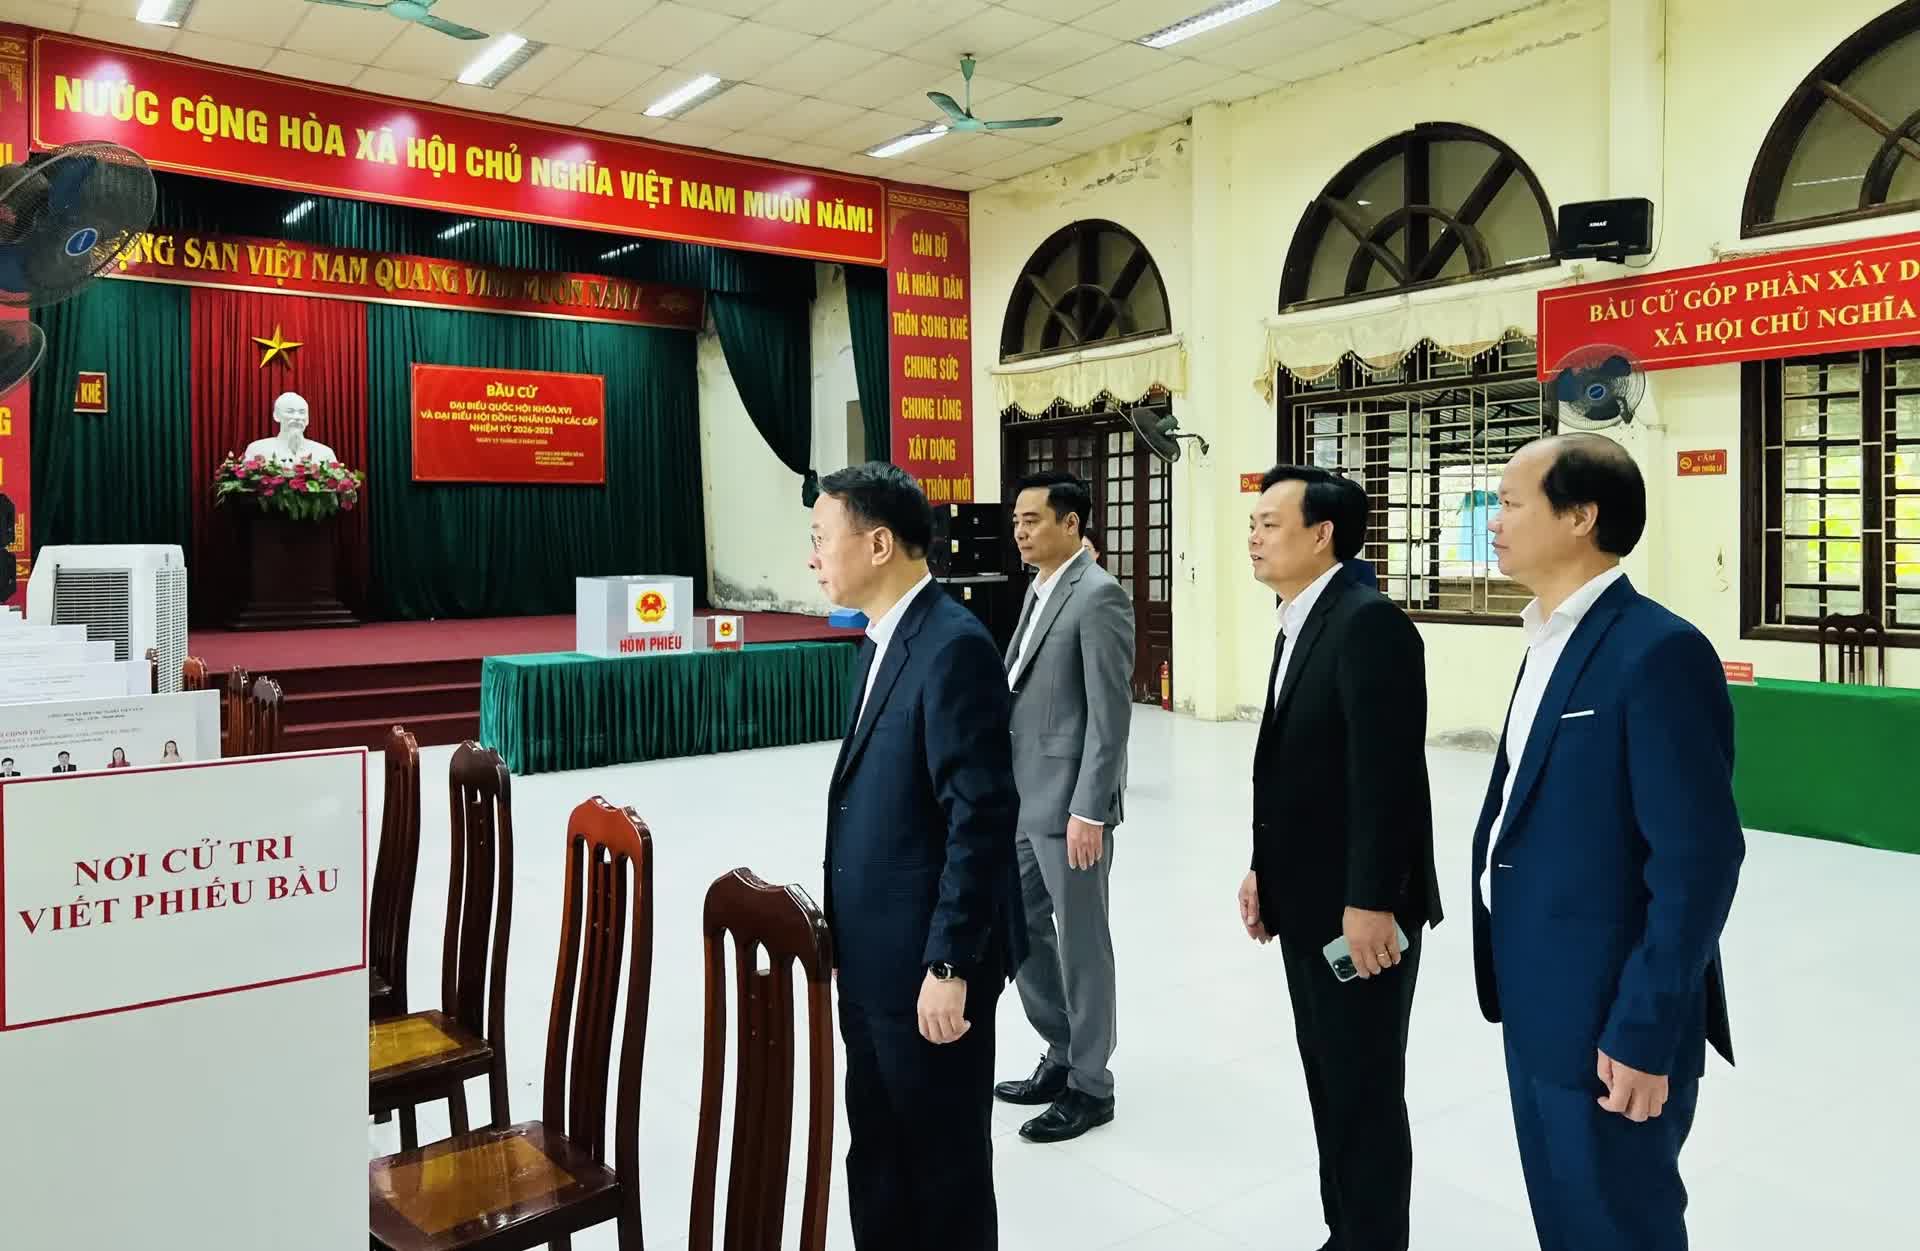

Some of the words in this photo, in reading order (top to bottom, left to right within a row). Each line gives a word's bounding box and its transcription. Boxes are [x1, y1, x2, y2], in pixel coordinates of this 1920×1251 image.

[55, 75, 159, 126] NƯỚC
[171, 94, 268, 145] CỘNG
[279, 112, 346, 158] HÒA
[355, 126, 398, 166] XÃ
[407, 134, 456, 178] HỘI
[466, 143, 522, 184] CHỦ
[531, 156, 614, 197] NGHĨA
[620, 169, 673, 209] VIỆT
[680, 180, 736, 215] NAM
[743, 190, 810, 225] MUÔN
[817, 198, 873, 233] NĂM!
[912, 229, 932, 256] CÁN
[935, 232, 948, 262] BỘ
[247, 240, 306, 287] VIỆT
[311, 252, 368, 286] NAM
[374, 257, 459, 294] QUANG
[896, 267, 910, 295] VÀ
[911, 271, 939, 298] NHÂN
[943, 273, 963, 300] DÂN
[1589, 297, 1635, 323] BẦU
[1641, 288, 1679, 316] CỬ
[1683, 281, 1737, 310] GÓP
[1745, 270, 1820, 301] PHẦN
[1827, 260, 1891, 291] XÂY
[892, 308, 918, 337] THÔN
[921, 315, 948, 339] SONG
[1654, 321, 1688, 348] XÃ
[1695, 317, 1744, 345] HỘI
[1750, 306, 1810, 336] CHỦ
[1817, 295, 1916, 328] NGHĨA
[904, 355, 937, 380] CHUNG
[939, 353, 959, 381] SỨC
[486, 381, 514, 397] BẦU
[517, 384, 538, 399] CỬ
[420, 408, 433, 419] VÀ
[473, 412, 490, 423] HỘI
[518, 413, 543, 424] NHÂN
[545, 415, 563, 425] DÂN
[564, 415, 580, 426] CÁC
[515, 403, 531, 414] HỘI
[558, 406, 572, 415] XVI
[901, 396, 935, 420] CHUNG
[937, 394, 962, 421] LÒNG
[469, 422, 498, 434] NHIỆM
[908, 434, 928, 461] XÂY
[929, 436, 956, 464] DỰNG
[926, 475, 950, 501] THÔN
[953, 473, 971, 500] MỚI
[650, 632, 682, 651] PHIẾU
[73, 852, 150, 887] NƠI
[162, 838, 222, 874] CỬ
[229, 835, 295, 866] TRI
[18, 895, 120, 934] VIẾT
[133, 876, 254, 920] PHIẾU
[266, 865, 340, 901] BẦU
